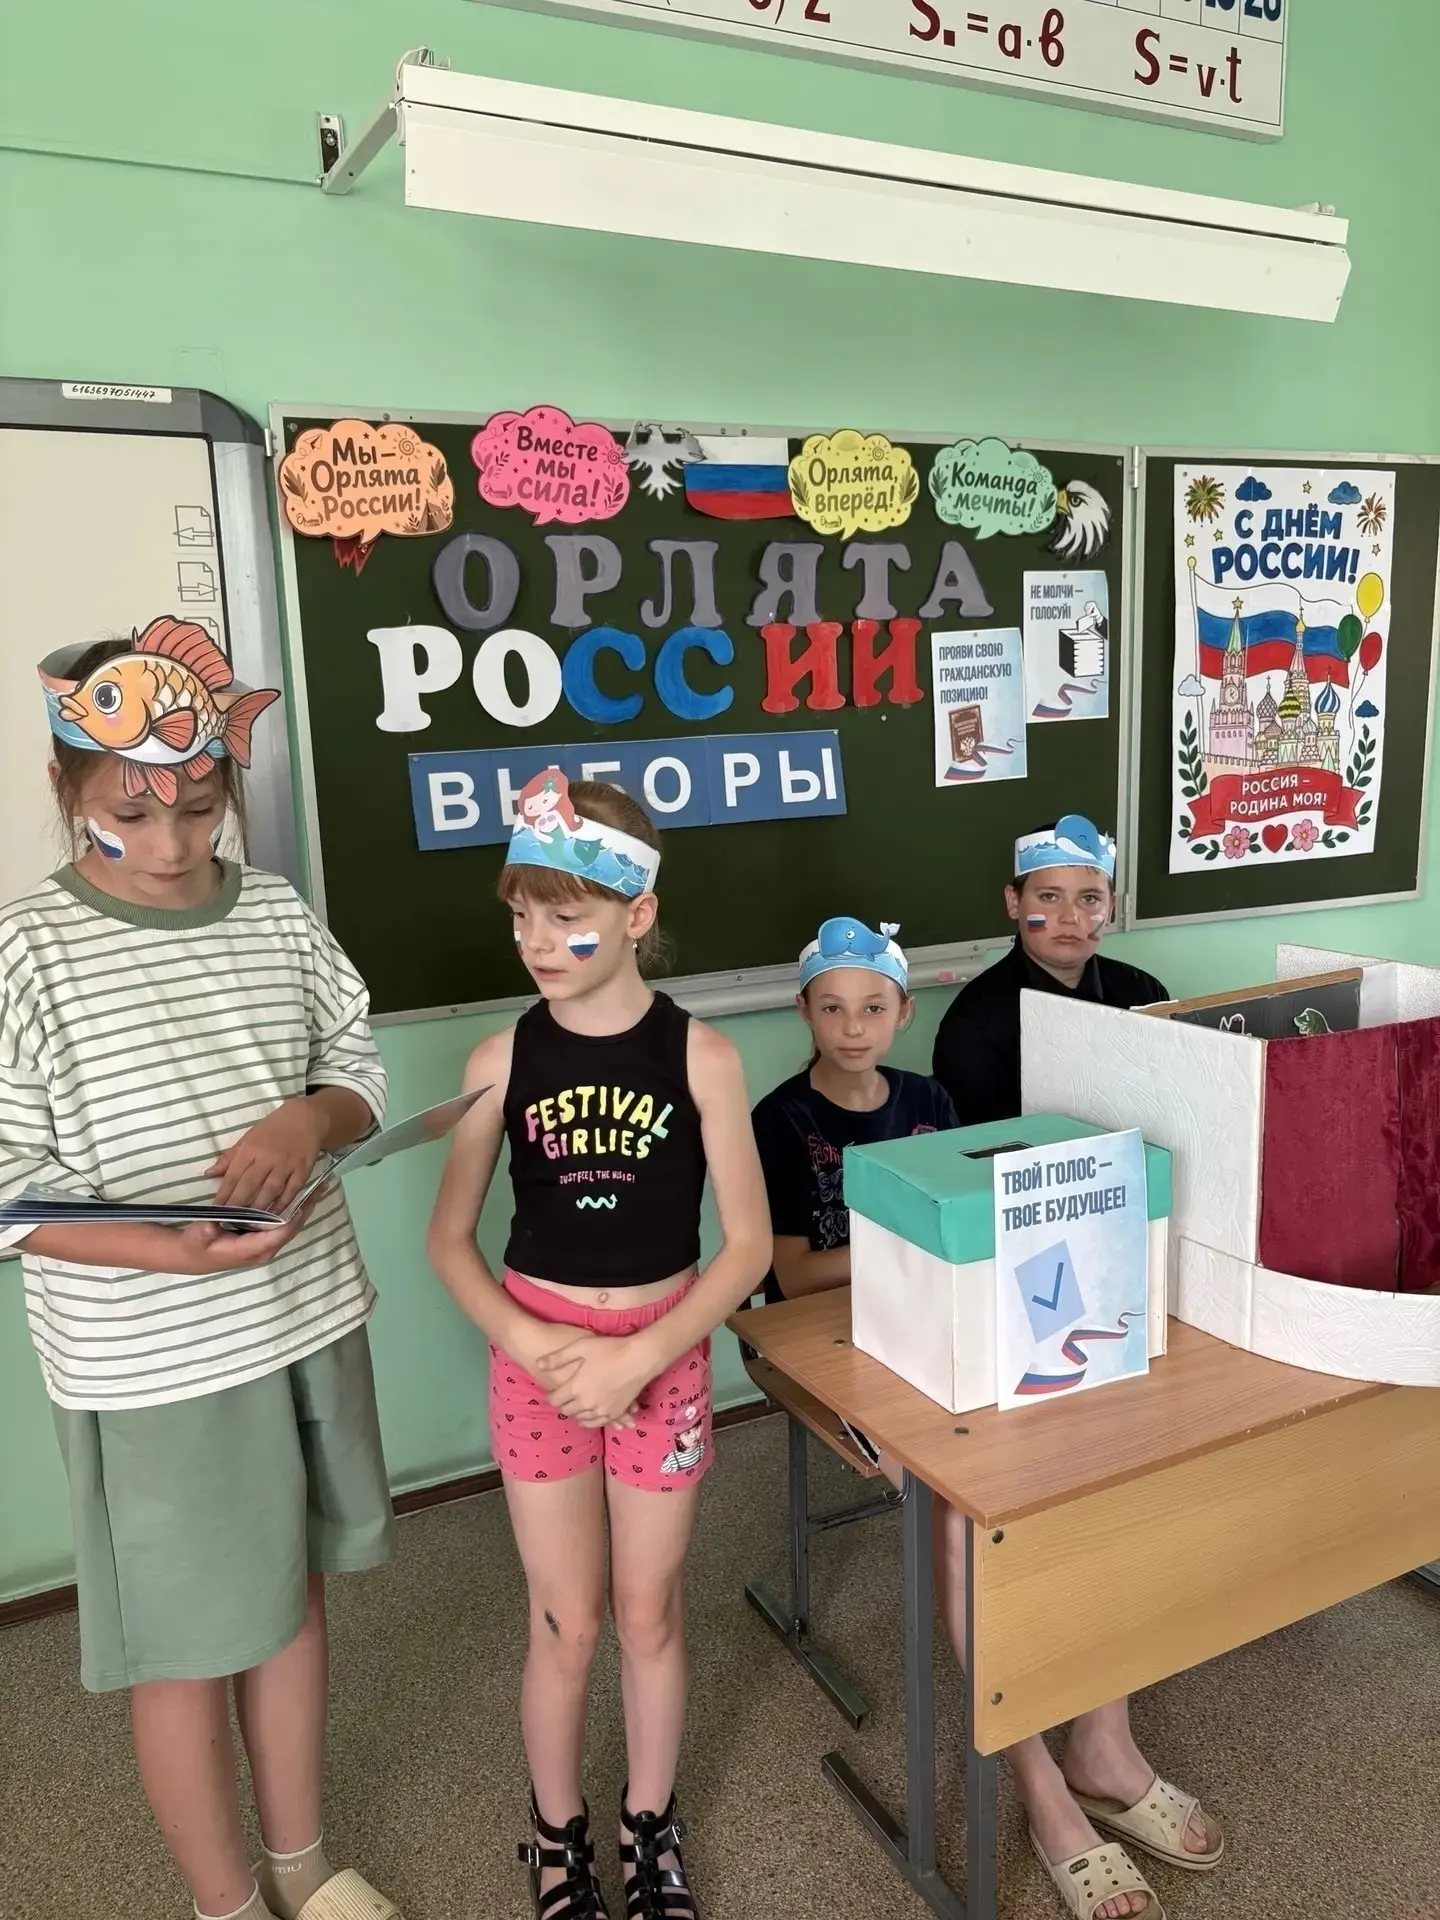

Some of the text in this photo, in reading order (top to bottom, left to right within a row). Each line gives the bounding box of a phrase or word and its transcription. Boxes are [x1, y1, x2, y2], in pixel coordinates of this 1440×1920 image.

[332, 437, 378, 466] Мы
[517, 426, 598, 462] Вместе
[311, 460, 422, 498] Орлята
[808, 458, 898, 492] Орлята,
[951, 461, 1038, 499] Команда
[322, 488, 422, 521] России!
[815, 485, 895, 519] вперёд!
[953, 492, 1036, 518] мечты!
[1234, 503, 1343, 541] С ДНЁМ
[1212, 542, 1360, 584] РОССИИ!
[431, 533, 995, 631] ОРЛЯТА
[1030, 585, 1042, 599] НЕ
[1043, 584, 1073, 599] МОЛЧИ
[1030, 603, 1072, 620] ГОЛОСУЙ!
[938, 642, 1003, 661] ПРОЯВИ СВОЮ
[366, 618, 925, 733] РОССИИ
[939, 663, 1012, 682] ГРАЖДАНСКУЮ
[940, 686, 988, 704] ПОЗИЦИЮ!
[1242, 774, 1298, 795] РОССИЯ
[1230, 792, 1327, 816] РОДИНА МОЯ!
[525, 1085, 674, 1143] FESTIVAL
[542, 1128, 652, 1159] GIRLIES
[577, 1170, 594, 1183] FEEL
[596, 1170, 610, 1180] THE
[1002, 1161, 1042, 1195] ТВОЙ
[1046, 1155, 1096, 1187] ГОЛОС
[1002, 1185, 1126, 1232] ТВОЕ БУДУЩЕЕ!
